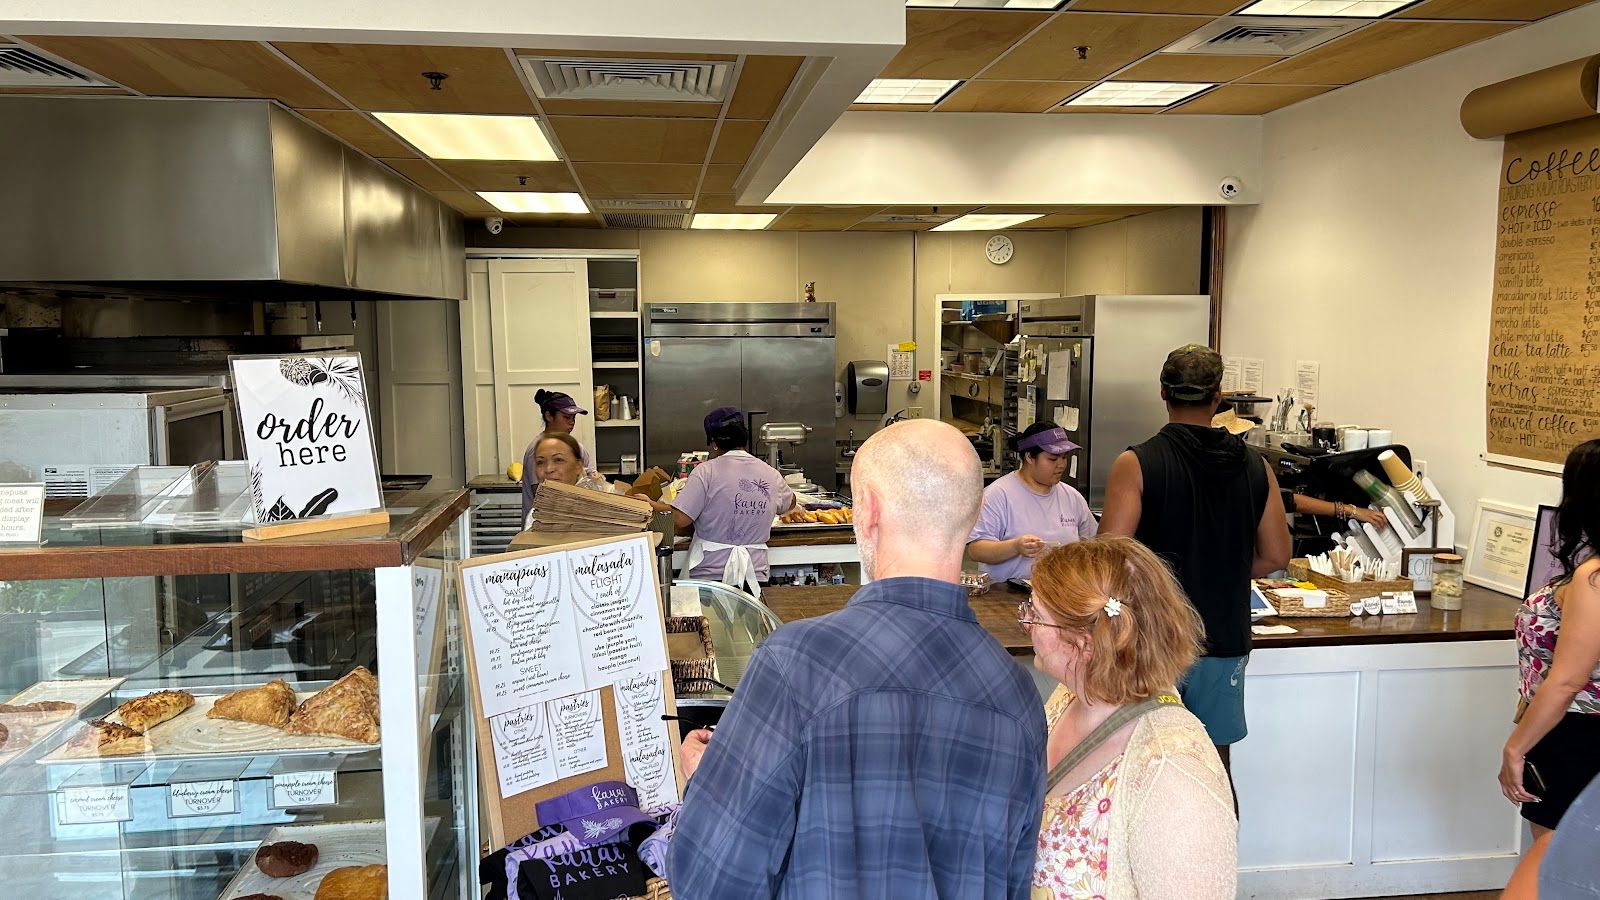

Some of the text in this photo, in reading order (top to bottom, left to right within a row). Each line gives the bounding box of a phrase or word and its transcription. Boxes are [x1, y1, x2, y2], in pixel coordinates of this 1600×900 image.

[1503, 201, 1559, 221] espresso
[1508, 222, 1525, 234] HOT
[1533, 220, 1552, 232] ICED
[1500, 235, 1555, 248] double espresso
[1499, 252, 1534, 261] americano
[1519, 261, 1540, 274] latte
[1498, 275, 1543, 288] vanilla latte
[1496, 287, 1580, 301] macadamia nut latte
[1495, 302, 1548, 315] caramel latte
[1495, 316, 1540, 328] mocha latte
[1495, 329, 1514, 342] white
[1516, 331, 1541, 342] mocha
[1543, 329, 1565, 342] latte
[1526, 343, 1543, 357] tea
[1546, 343, 1573, 358] latte
[257, 397, 361, 443] order
[1490, 408, 1534, 433] brewed
[1538, 414, 1578, 438] coffee
[1520, 433, 1536, 447] HOT
[276, 442, 346, 467] here
[575, 552, 634, 576] malasada
[485, 566, 549, 587] manapuas
[590, 574, 623, 589] FLIGHT
[504, 585, 534, 596] SAVORY
[600, 585, 613, 599] each
[582, 623, 608, 633] chocolate
[608, 619, 621, 627] with
[519, 664, 542, 675] SWEET
[560, 698, 590, 717] pastries
[503, 712, 535, 732] pastries
[629, 746, 665, 763] malasadas
[216, 784, 233, 794] cheese
[274, 780, 301, 789] pineapple
[317, 776, 333, 785] cheese
[107, 792, 124, 801] cheese
[287, 788, 322, 796] TURNOVER
[80, 803, 116, 811] TURNOVER
[185, 796, 221, 805] TURNOVER
[597, 797, 628, 810] BAKERY
[549, 862, 630, 889] BAKERY
